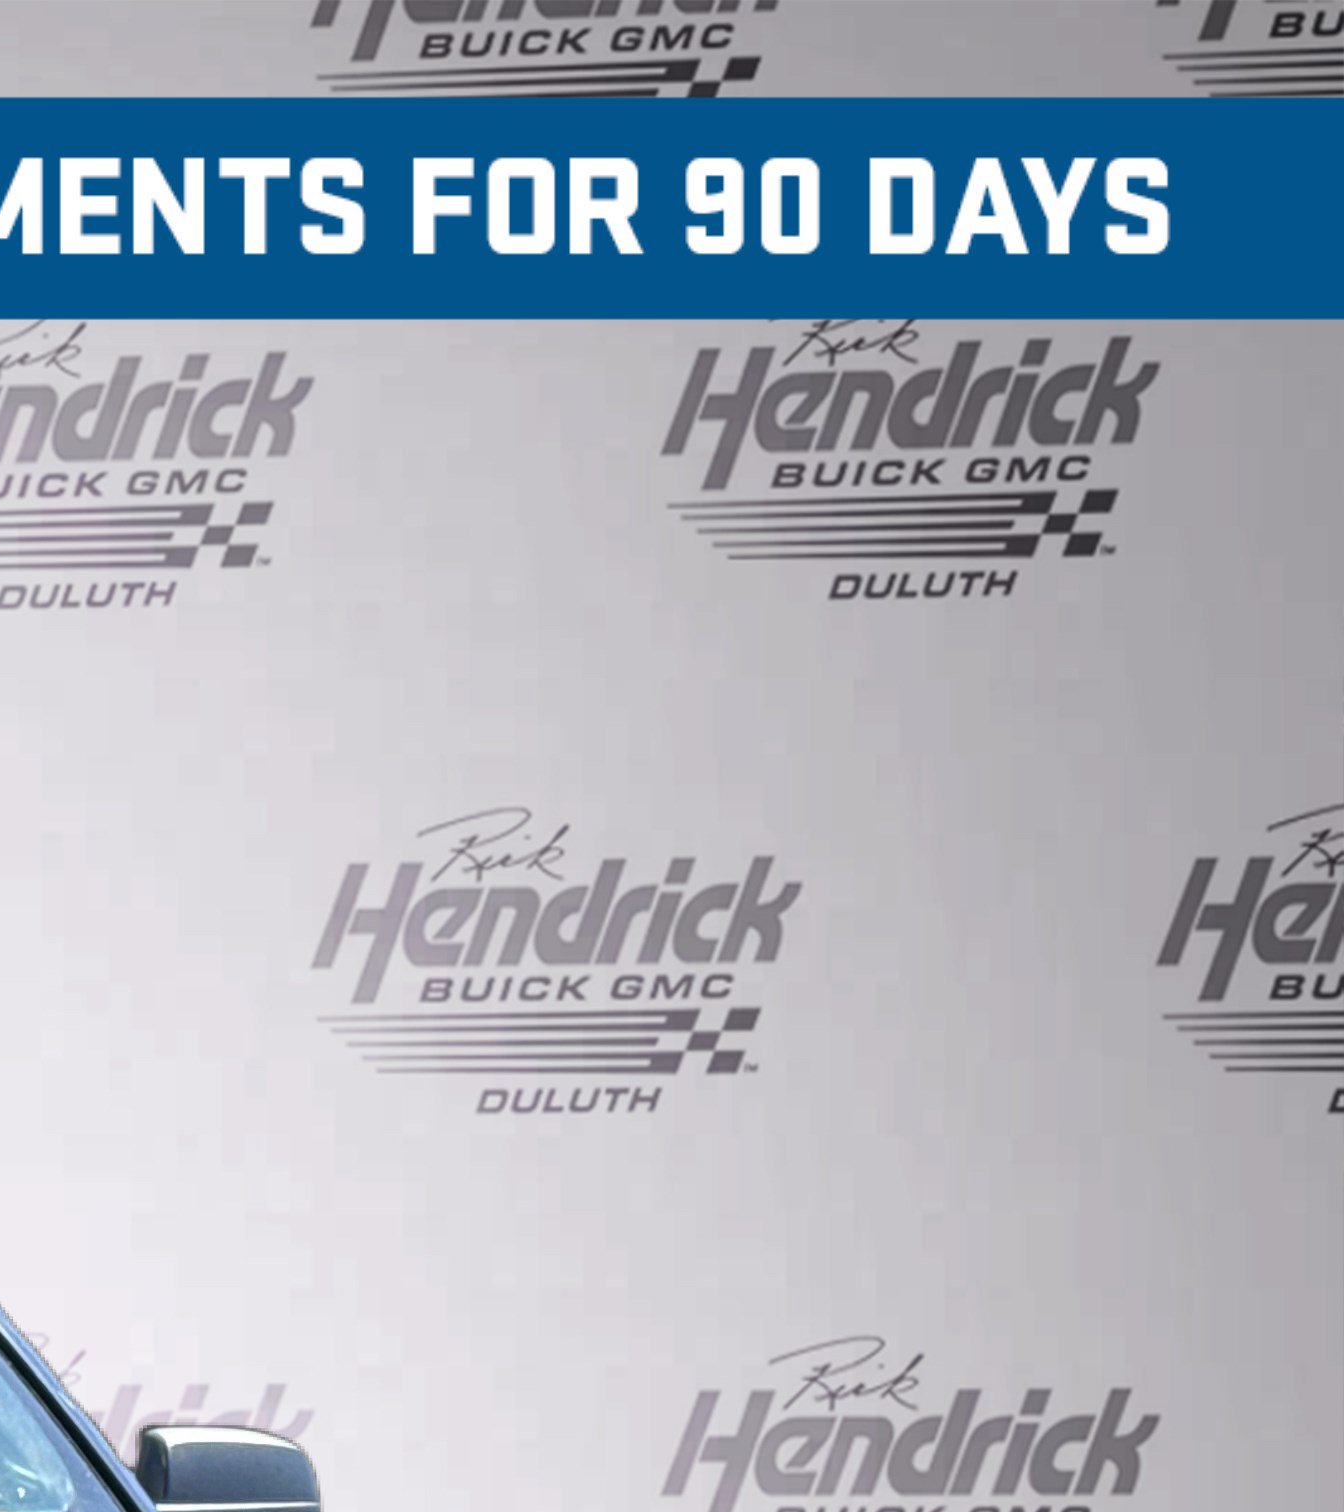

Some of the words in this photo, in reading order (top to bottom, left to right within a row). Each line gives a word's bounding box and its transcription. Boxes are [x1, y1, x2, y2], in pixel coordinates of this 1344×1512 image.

[419, 29, 589, 59] BUICK
[610, 23, 734, 52] GMC
[660, 336, 1159, 491] Hendrick
[126, 468, 248, 496] GMC
[771, 459, 944, 488] BUICK
[964, 455, 1091, 483] GMC
[828, 571, 1017, 600] DULUTH
[310, 856, 802, 1005] Hendrick
[419, 976, 590, 1003] BUICK
[610, 973, 734, 1000] GMC
[475, 1087, 661, 1115] DULUTH
